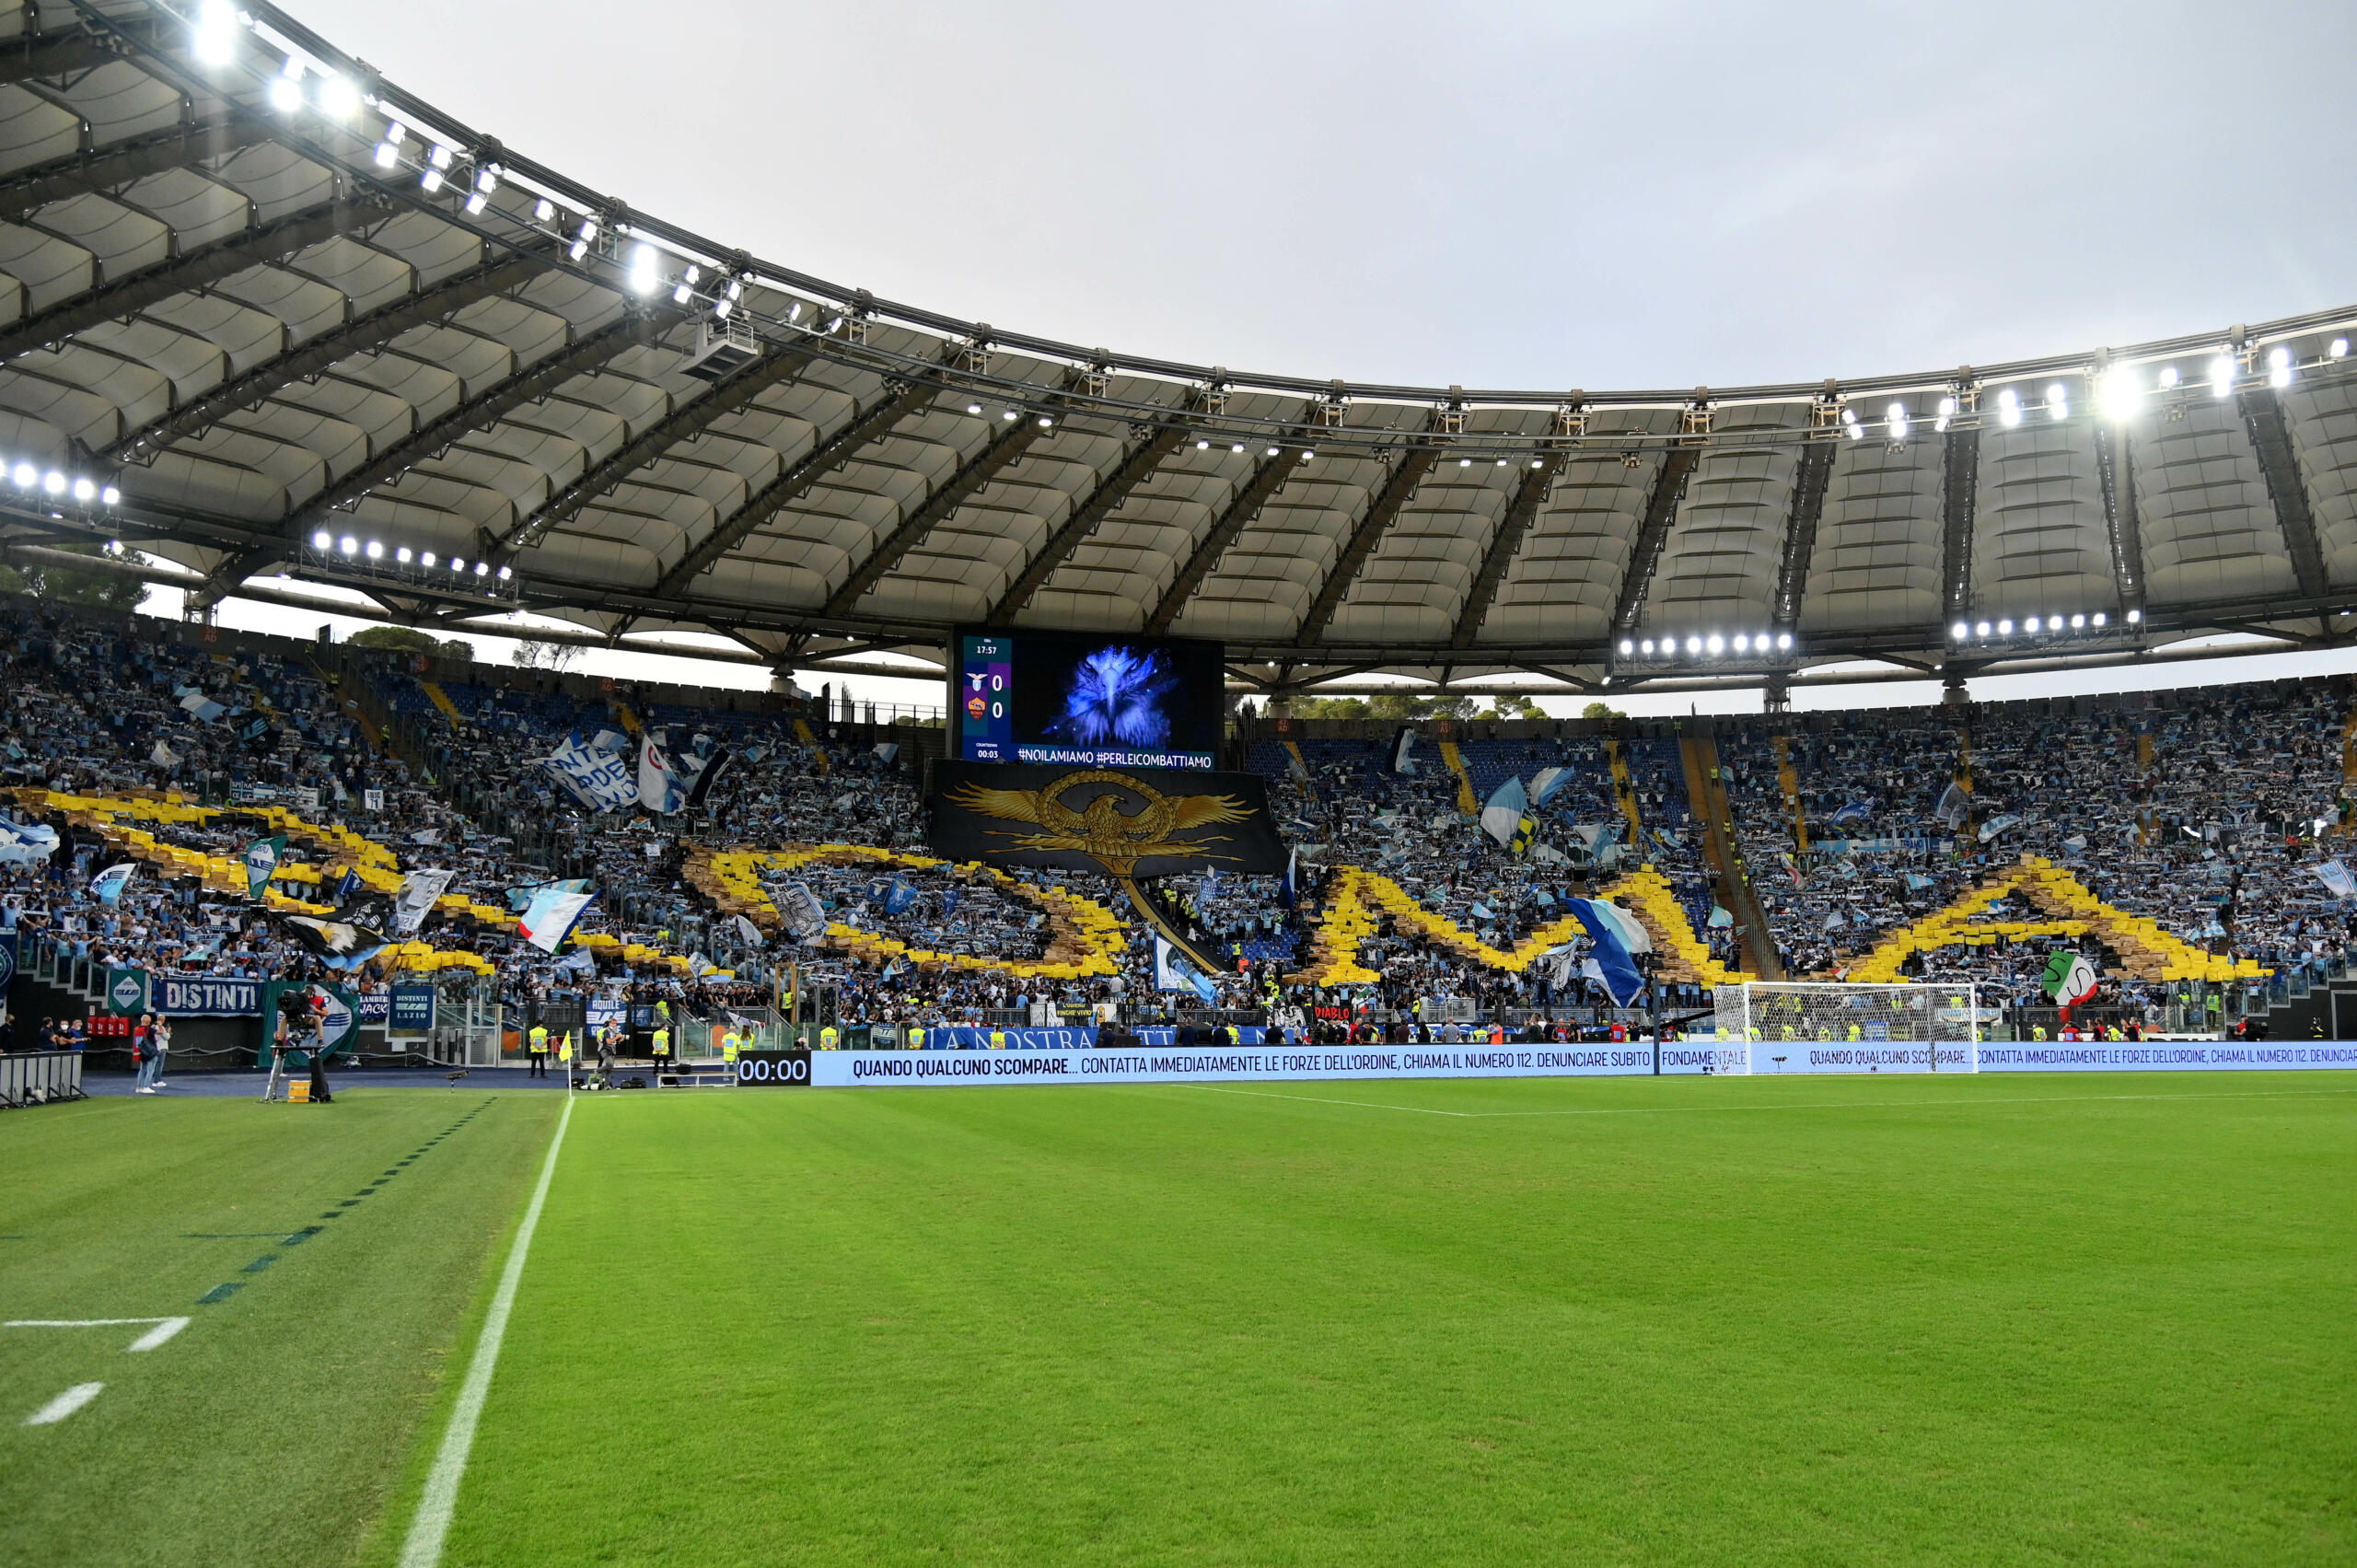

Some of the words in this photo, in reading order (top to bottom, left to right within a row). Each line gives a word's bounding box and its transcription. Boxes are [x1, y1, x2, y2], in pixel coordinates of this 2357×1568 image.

[977, 645, 997, 655] 17:57
[992, 675, 1003, 691] 0
[992, 702, 1004, 718] 0
[978, 749, 999, 759] 00:03
[1017, 748, 1094, 763] #NOILAMIAMO
[1097, 751, 1212, 769] #PERLEICOMBATTIAMO
[1899, 838, 1923, 849] TERAMO
[167, 982, 256, 1010] DISTINTI
[359, 1003, 389, 1015] JACK
[592, 1000, 620, 1011] AQUILE
[1315, 1005, 1350, 1020] DIABLO
[853, 1060, 911, 1078] QUANDO
[917, 1059, 990, 1078] QUALCUNO
[994, 1059, 1077, 1075] SCOMPARE...
[1082, 1057, 1147, 1074] CONTATTA
[1151, 1056, 1261, 1073] IMMEDIATAMENTE
[1266, 1055, 1279, 1071] LE
[1283, 1055, 1320, 1071] FORZE
[1325, 1054, 1400, 1073] DELL'ORDINE,
[1404, 1054, 1450, 1069] CHIAMA
[1453, 1053, 1462, 1068] IL
[1466, 1053, 1514, 1068] NUMERO
[1517, 1052, 1535, 1068] 112.
[1538, 1052, 1608, 1067] DENUNCIARE
[1611, 1051, 1650, 1066] SUBITO
[1662, 1051, 1747, 1065] FONDAMENTALE
[1810, 1051, 1852, 1066] QUANDO
[1855, 1050, 1910, 1066] QUALCUNO
[1977, 1050, 2023, 1063] CONTATTA
[2026, 1050, 2107, 1063] IMMEDIATAMENTE
[2110, 1050, 2119, 1063] LE
[2123, 1050, 2150, 1063] FORZE
[2154, 1050, 2209, 1064] DELL'ORDINE,
[2212, 1050, 2246, 1063] CHIAMA
[2248, 1050, 2255, 1063] IL
[2258, 1050, 2293, 1063] NUMERO
[2295, 1050, 2308, 1063] 112.
[739, 1059, 807, 1081] 00:00
